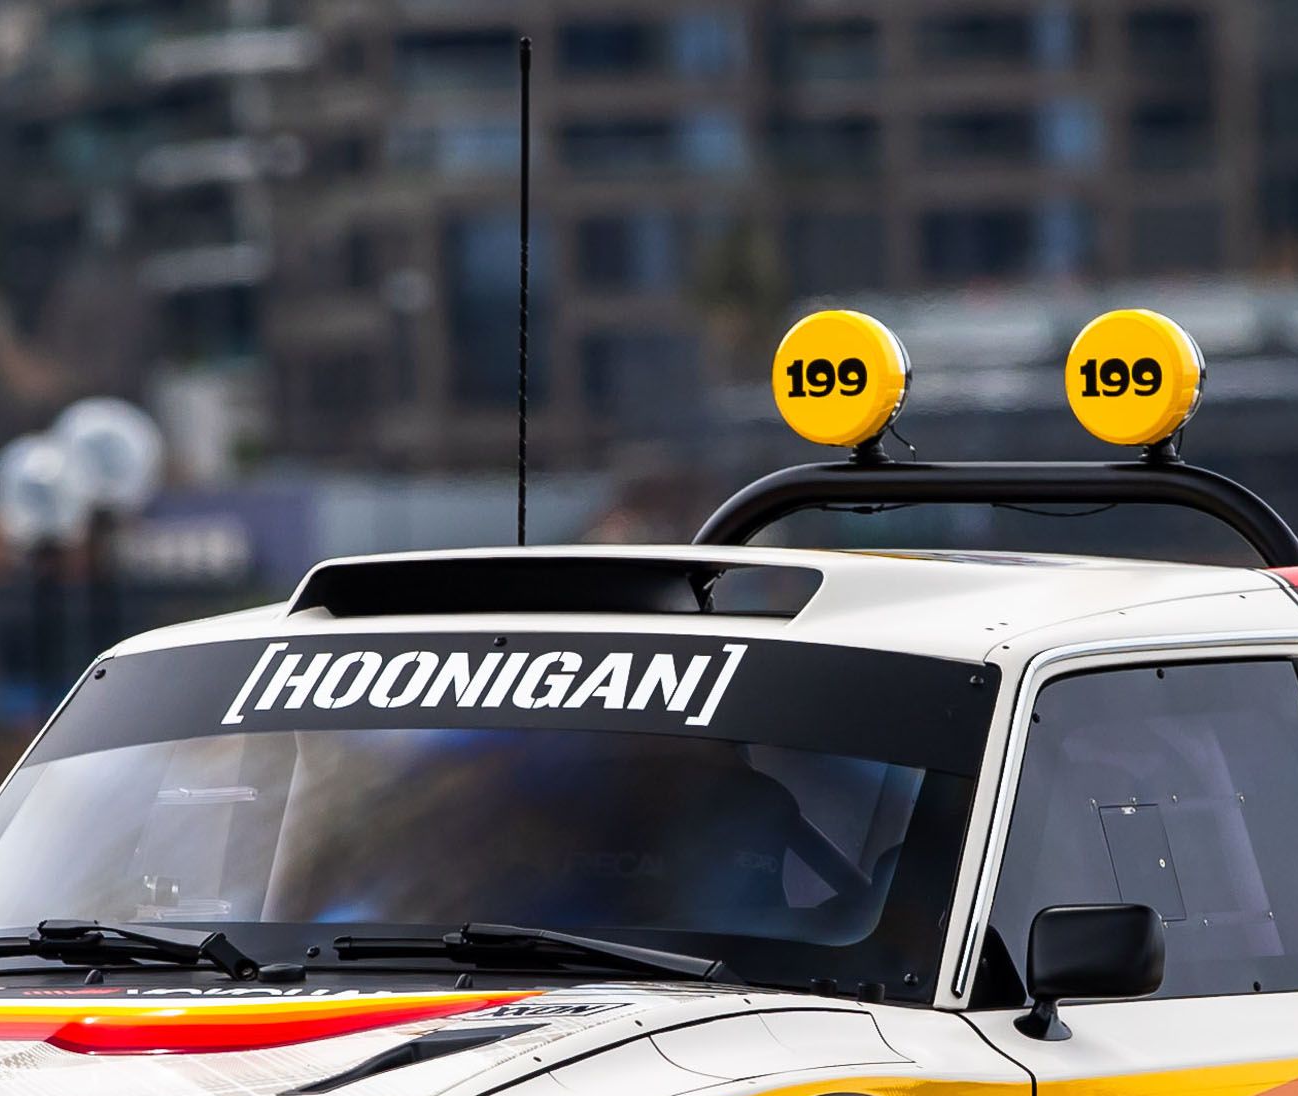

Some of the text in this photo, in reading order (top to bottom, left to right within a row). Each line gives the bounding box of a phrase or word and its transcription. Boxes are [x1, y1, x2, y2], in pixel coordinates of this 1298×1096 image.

[786, 357, 868, 398] 199
[1080, 356, 1163, 397] 199
[220, 641, 749, 727] [HOONIGAN]
